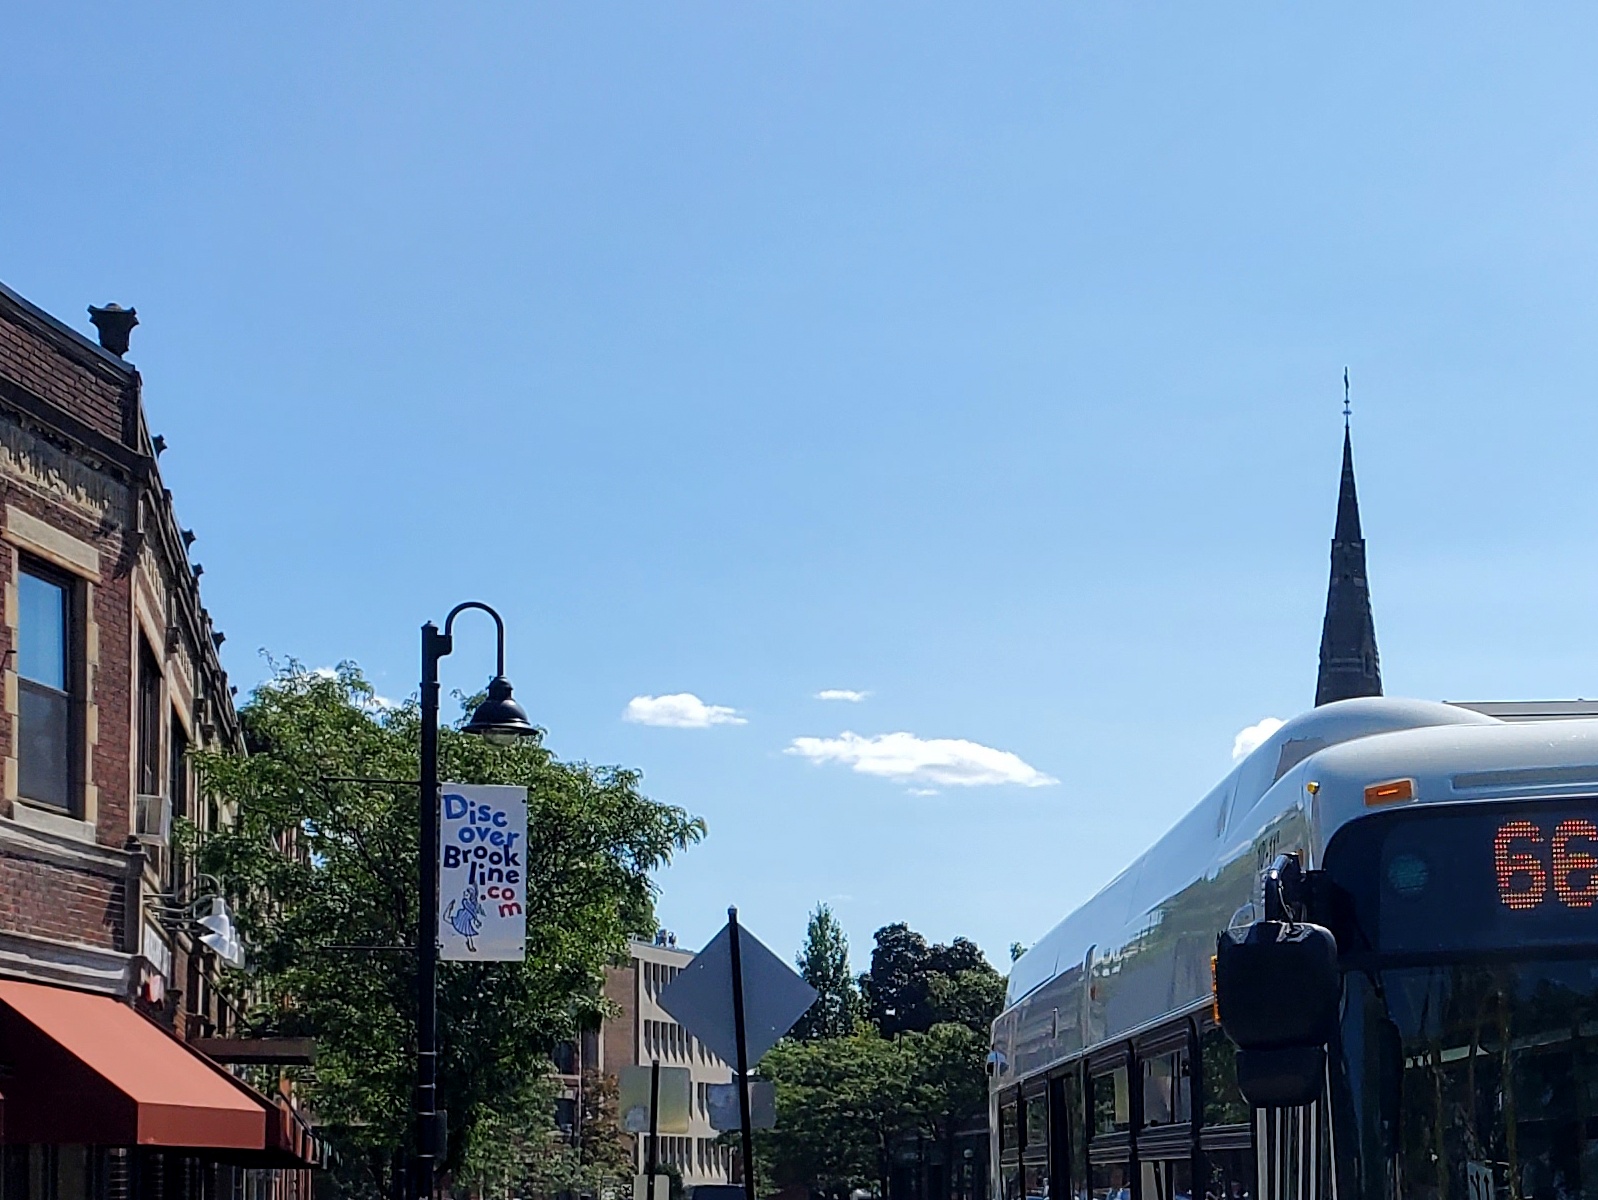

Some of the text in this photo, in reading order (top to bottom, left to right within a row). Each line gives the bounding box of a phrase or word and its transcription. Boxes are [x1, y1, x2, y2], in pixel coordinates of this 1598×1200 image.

[443, 794, 508, 828] Disc
[458, 827, 520, 848] over
[443, 844, 521, 868] Brook
[468, 861, 520, 885] line
